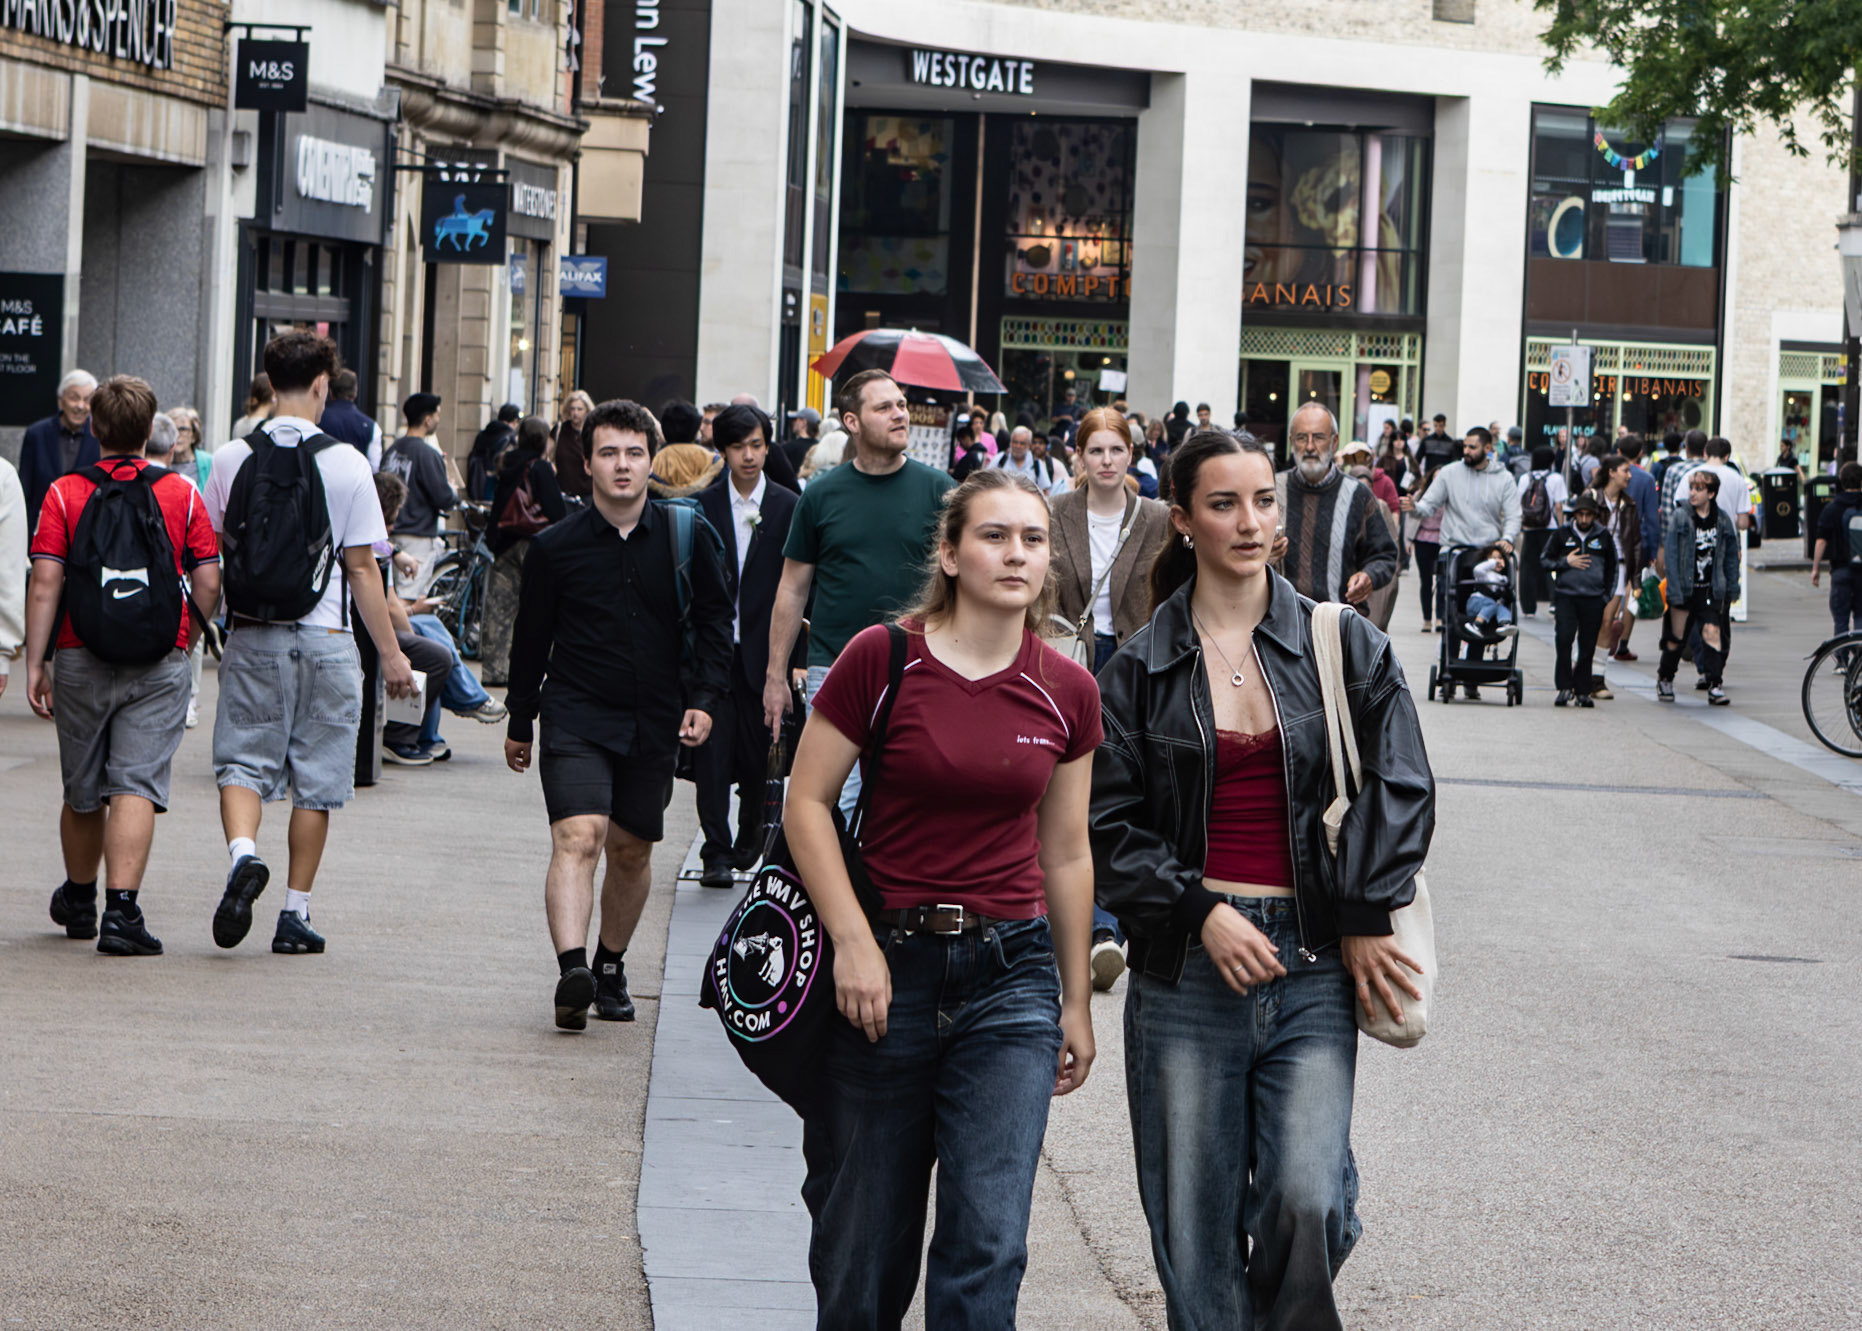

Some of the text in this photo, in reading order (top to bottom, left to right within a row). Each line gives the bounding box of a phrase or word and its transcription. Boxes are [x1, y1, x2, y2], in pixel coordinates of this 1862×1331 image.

[249, 60, 295, 81] M&S
[632, 36, 669, 114] Lew
[912, 49, 1034, 94] WESTGATE
[559, 270, 603, 283] ALIFAX
[1241, 281, 1352, 307] ANAIS
[0, 299, 34, 315] M&S
[0, 313, 44, 336] AFÉ
[1624, 377, 1703, 398] LIBANAIS
[766, 875, 807, 912] HMV
[795, 913, 817, 988] SHOP
[716, 957, 772, 1032] HMV.COM
